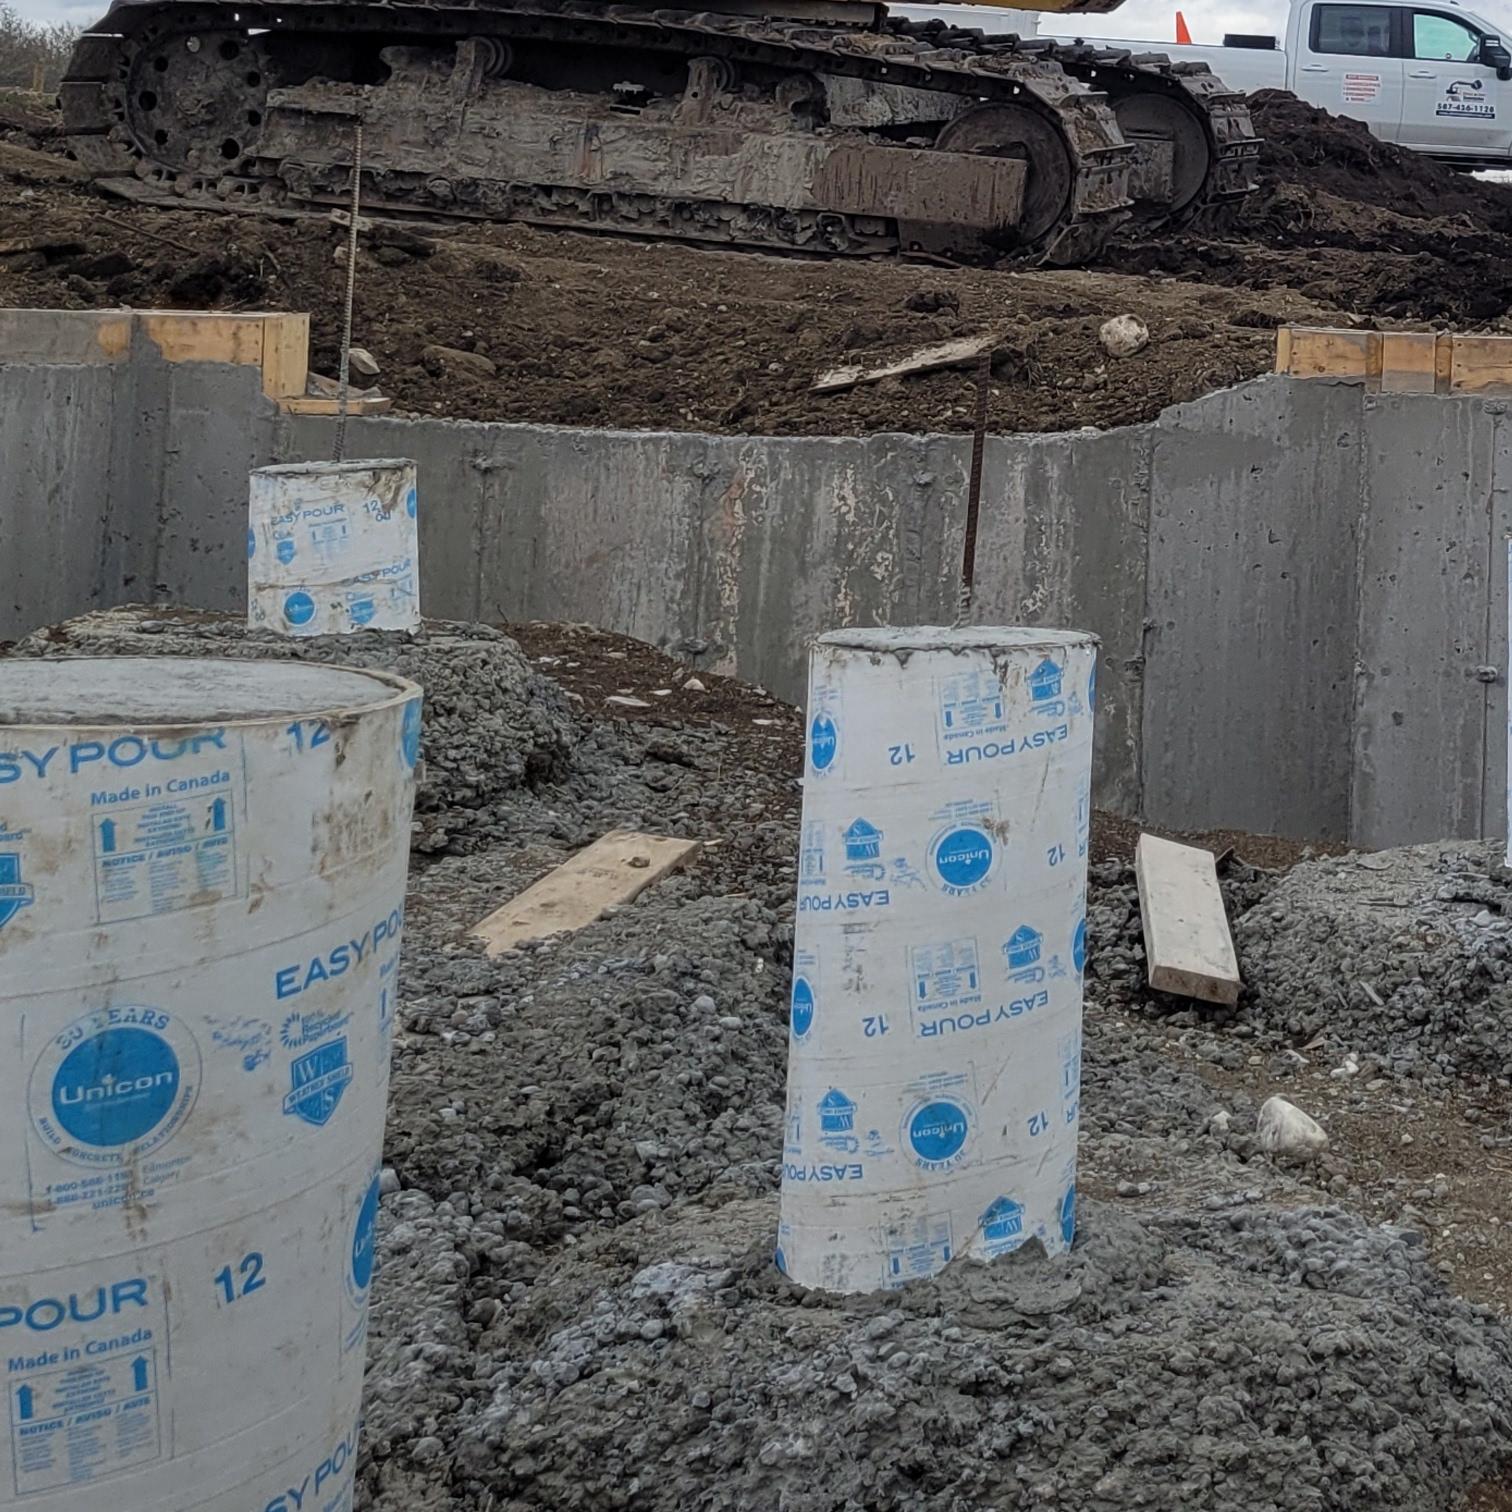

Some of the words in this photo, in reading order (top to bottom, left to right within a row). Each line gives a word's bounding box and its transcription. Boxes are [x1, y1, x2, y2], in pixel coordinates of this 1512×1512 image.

[303, 503, 345, 519] POUR
[363, 500, 379, 514] 12
[287, 720, 331, 751] 12
[888, 743, 916, 766] 12
[946, 738, 1016, 765] POUR
[91, 787, 141, 807] Made
[146, 783, 161, 799] in
[167, 768, 230, 794] Canada
[939, 848, 990, 866] Unicon
[1047, 843, 1066, 868] 12
[276, 931, 370, 999] EASY
[862, 1014, 889, 1038] 12
[919, 1008, 991, 1037] POUR
[59, 1071, 174, 1105] Unicon
[38, 1115, 62, 1146] BUILD
[912, 1122, 965, 1139] Unicon
[1027, 1110, 1050, 1137] 12
[214, 1252, 267, 1305] 12
[8, 1351, 60, 1373] Made
[64, 1346, 81, 1362] in
[85, 1328, 153, 1356] Canada
